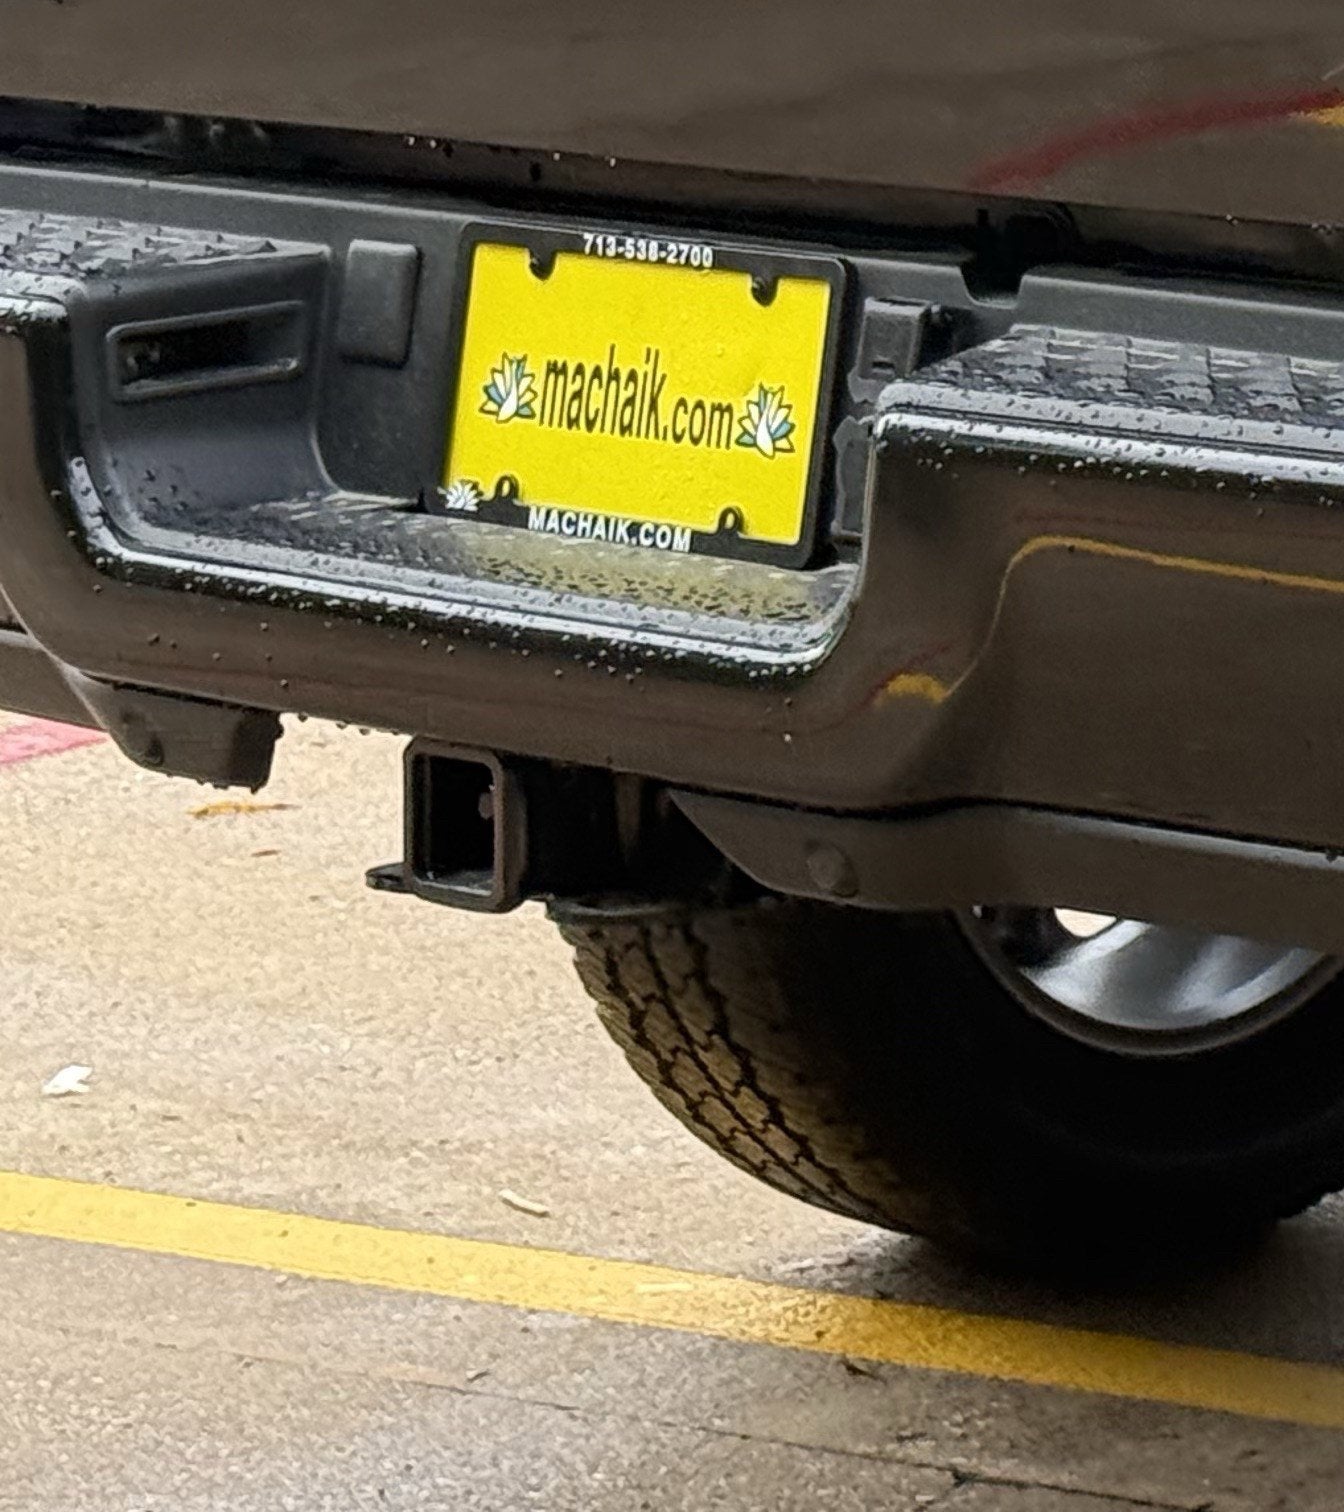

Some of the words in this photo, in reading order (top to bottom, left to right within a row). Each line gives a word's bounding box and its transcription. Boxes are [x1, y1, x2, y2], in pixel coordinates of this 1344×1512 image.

[583, 232, 713, 268] 713-538-2700
[539, 343, 734, 450] machaik.com
[527, 505, 692, 553] MACHAIK.COM
